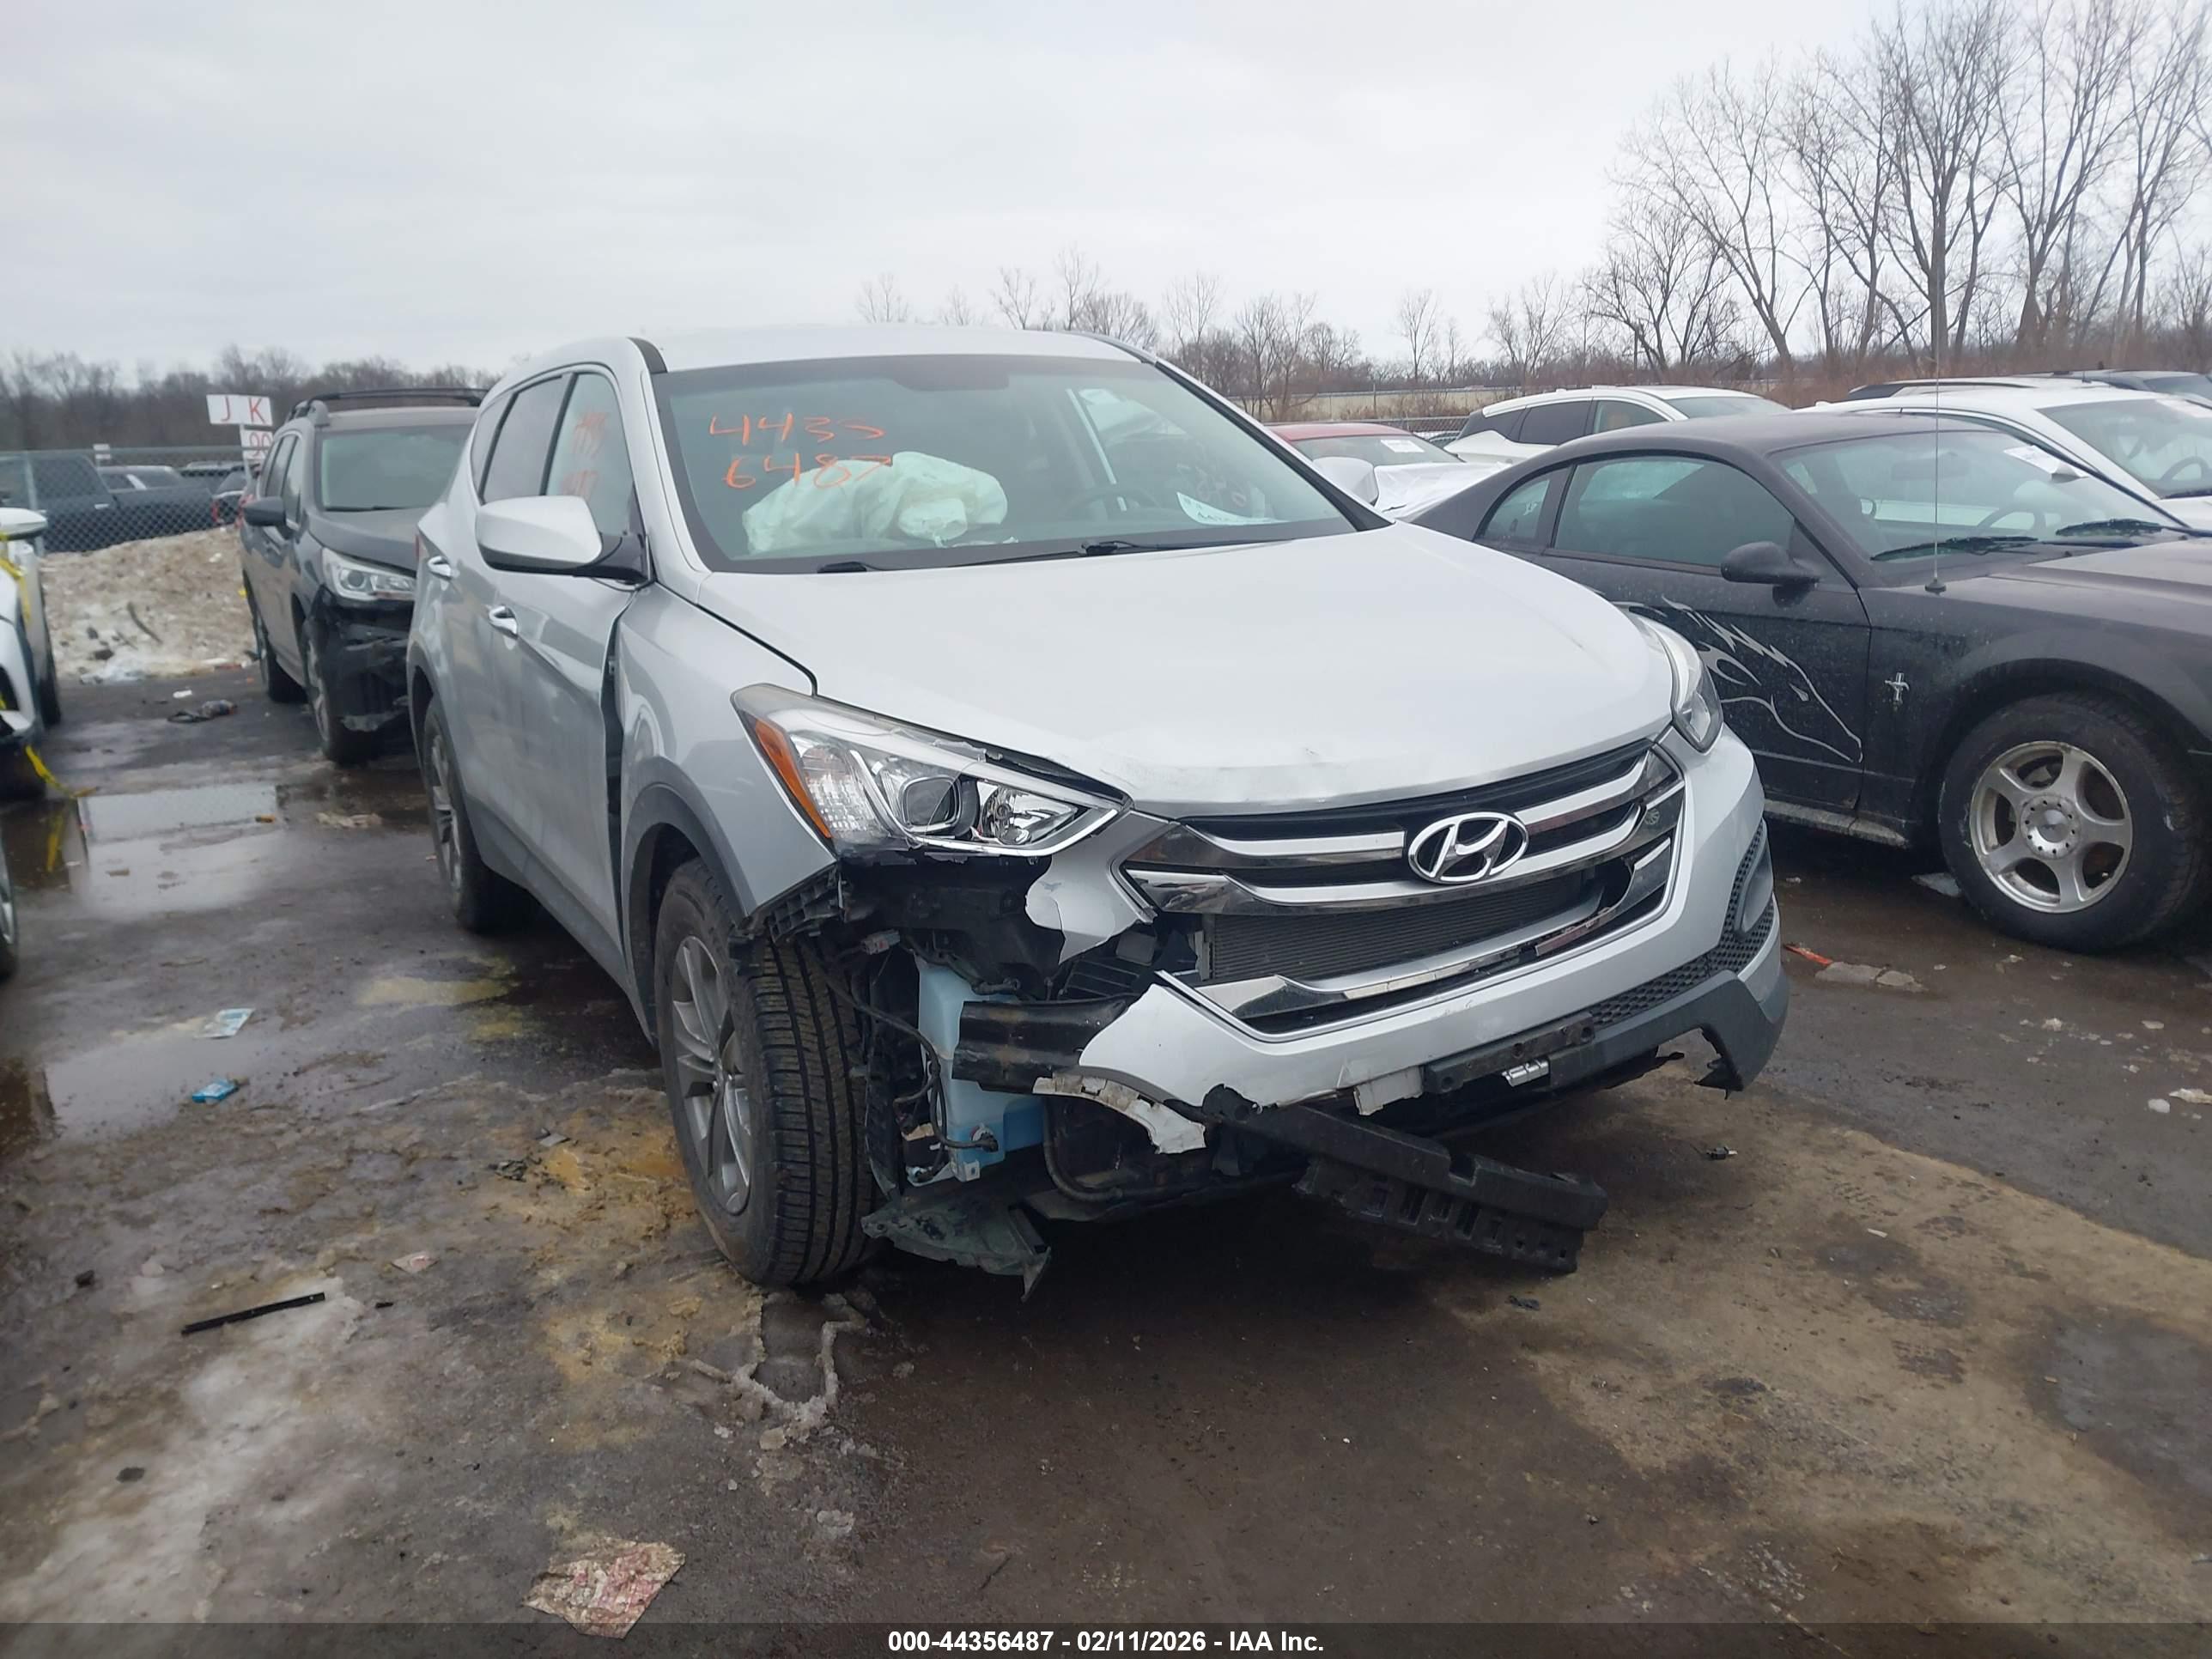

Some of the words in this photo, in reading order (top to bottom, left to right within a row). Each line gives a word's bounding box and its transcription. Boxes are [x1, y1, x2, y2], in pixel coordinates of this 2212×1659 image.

[221, 396, 231, 422] J
[248, 397, 266, 423] K
[722, 452, 893, 491] 6487
